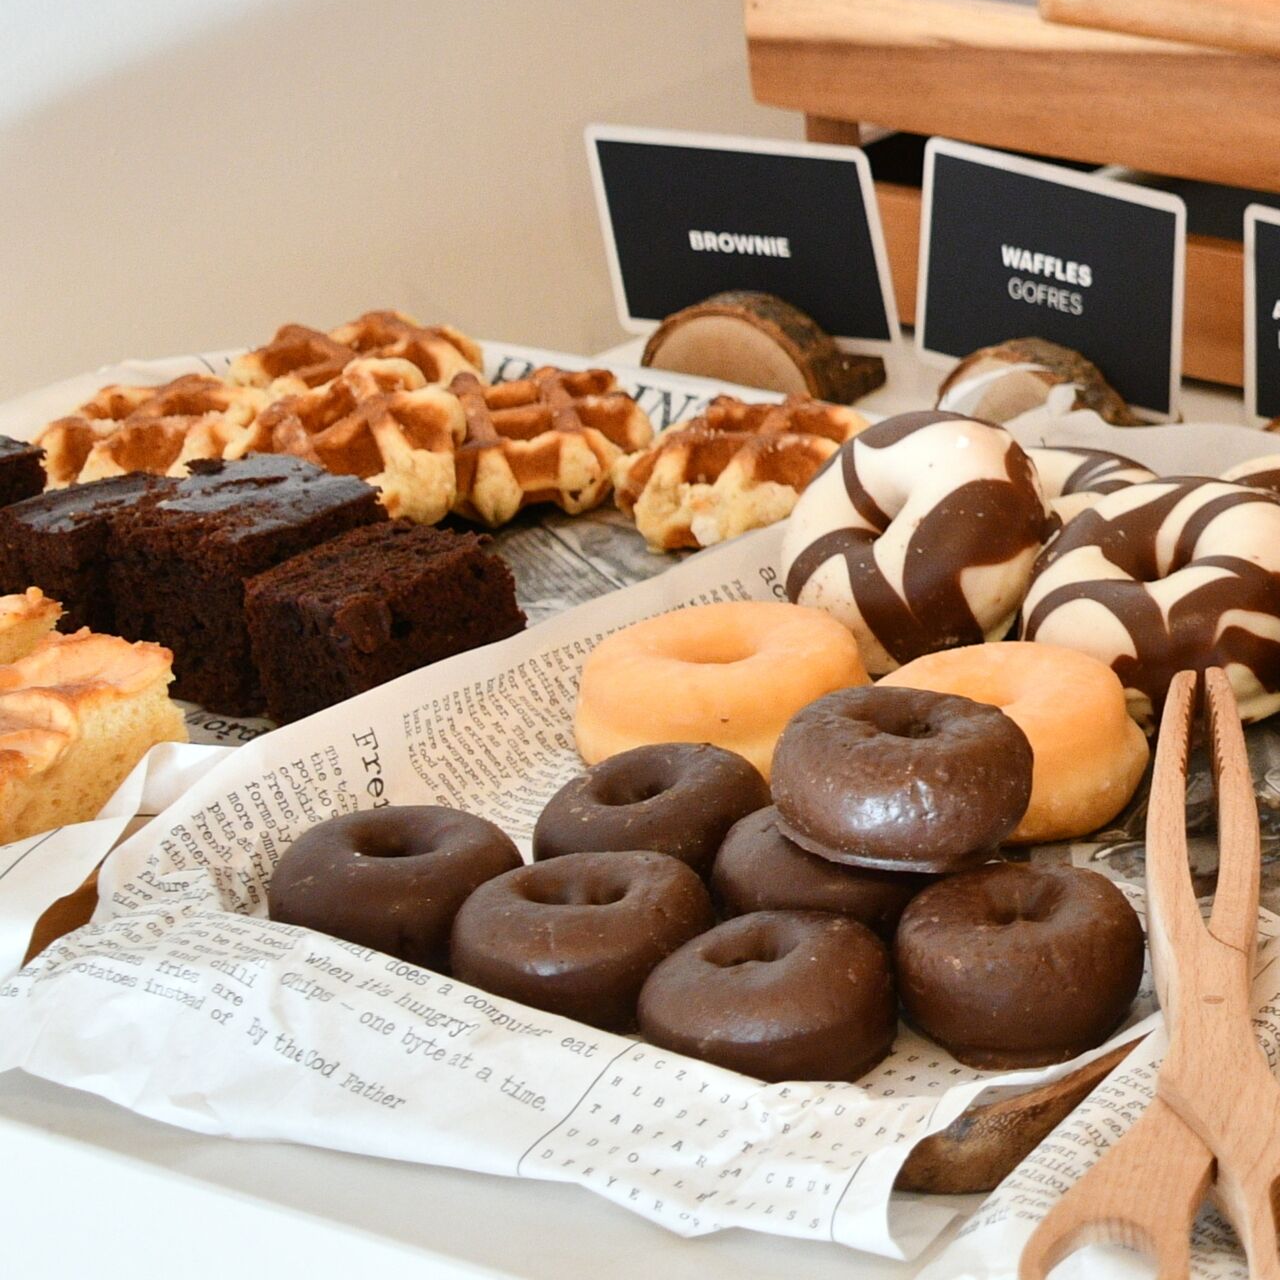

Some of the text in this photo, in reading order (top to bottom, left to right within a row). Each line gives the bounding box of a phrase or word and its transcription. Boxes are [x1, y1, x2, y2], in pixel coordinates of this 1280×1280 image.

[688, 229, 791, 259] BROWNIE
[1001, 244, 1093, 287] WAFFLES
[1008, 277, 1084, 316] GOFRES
[517, 662, 544, 704] batter
[528, 658, 560, 707] cutting
[554, 675, 576, 703] went
[432, 699, 444, 724] old
[425, 718, 437, 750] more
[452, 691, 512, 780] are extremely
[310, 752, 327, 782] the
[324, 745, 343, 776] The
[408, 744, 440, 791] without
[418, 740, 438, 769] food
[227, 792, 254, 831] more
[154, 960, 244, 1007] fries are
[210, 960, 258, 989] chili
[305, 951, 481, 1038] when it's hungry?
[384, 958, 431, 986] does
[437, 981, 455, 997] a
[463, 992, 554, 1039] computer
[560, 1036, 600, 1059] eat
[210, 1008, 235, 1026] of
[246, 1017, 268, 1046] By
[339, 1071, 408, 1111] Father
[359, 1011, 397, 1036] one
[401, 1027, 448, 1063] byte
[448, 1052, 474, 1071] at
[475, 1067, 494, 1083] a
[500, 1075, 547, 1113] time.
